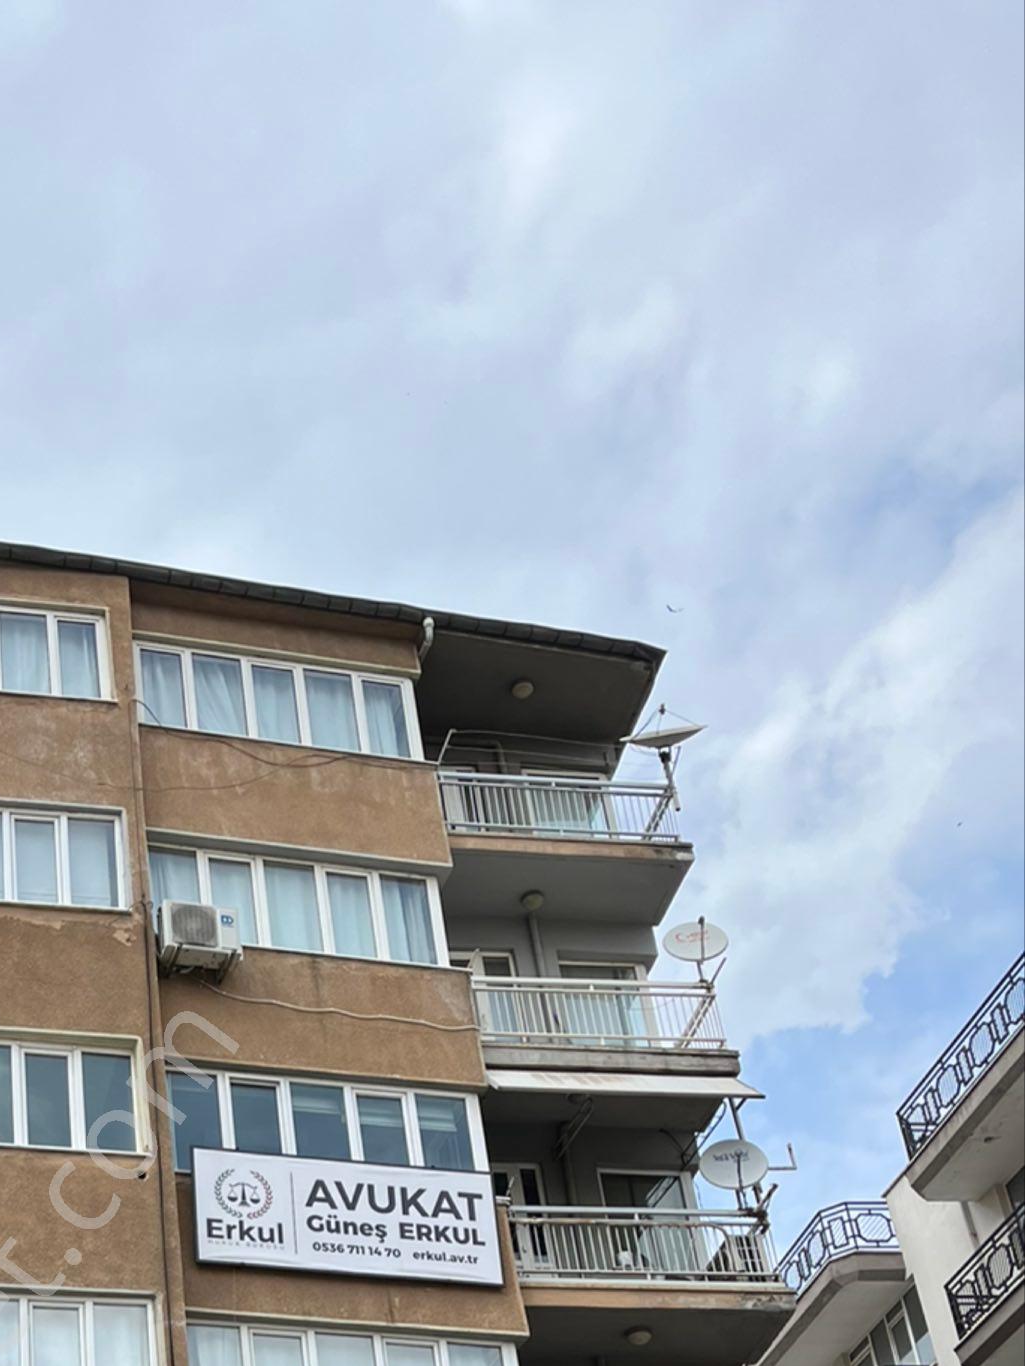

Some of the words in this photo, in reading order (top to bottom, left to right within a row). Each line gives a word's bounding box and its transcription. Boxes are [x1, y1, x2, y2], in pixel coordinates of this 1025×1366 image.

[306, 1178, 484, 1222] AVUKAT
[206, 1218, 285, 1245] Erkul
[307, 1213, 388, 1243] Güneş
[399, 1221, 486, 1247] ERKUL
[312, 1241, 345, 1255] 0536
[346, 1243, 366, 1256] 711
[367, 1244, 382, 1257] 14
[384, 1246, 402, 1259] 70
[412, 1249, 479, 1265] erkul.av.tr
